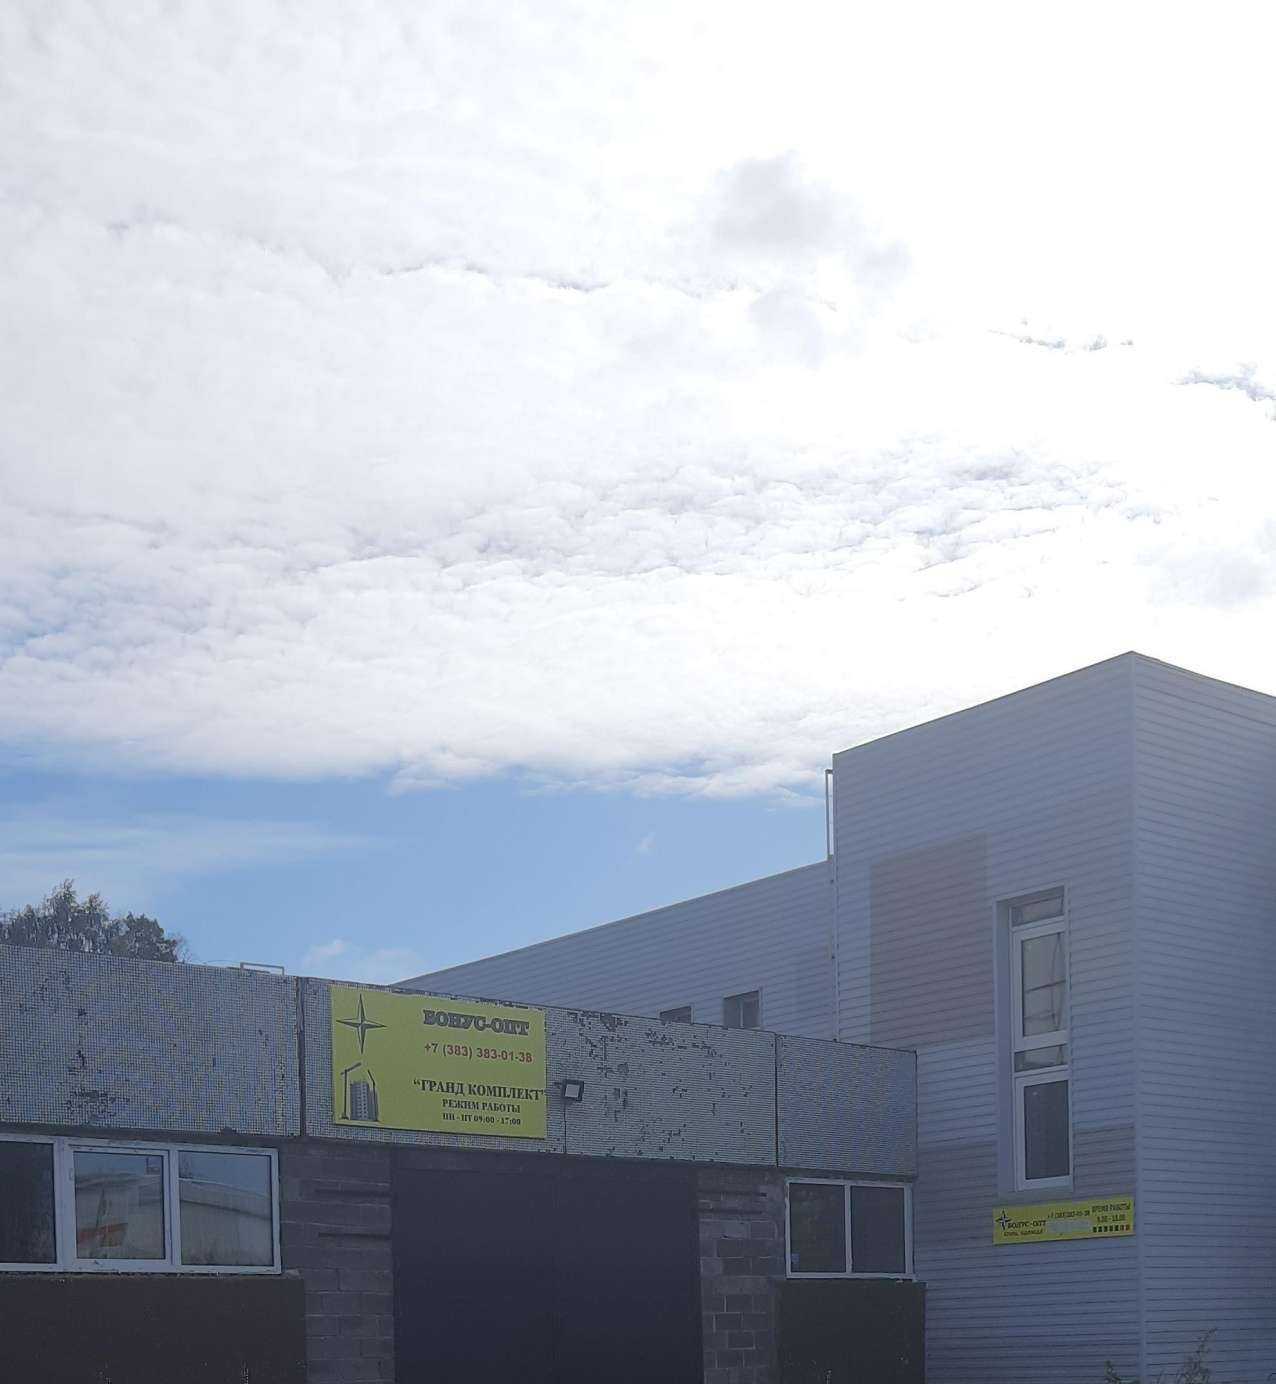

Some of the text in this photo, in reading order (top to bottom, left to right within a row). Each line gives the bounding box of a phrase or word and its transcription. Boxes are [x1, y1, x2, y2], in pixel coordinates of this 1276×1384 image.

[423, 1009, 529, 1036] БОНУС-ОПТ
[424, 1043, 533, 1063] +7 (383) 383-01-38
[442, 1099, 521, 1114] РЕЖИМ РАБОТЫ
[442, 1113, 455, 1121] ПН
[461, 1114, 473, 1122] ПТ
